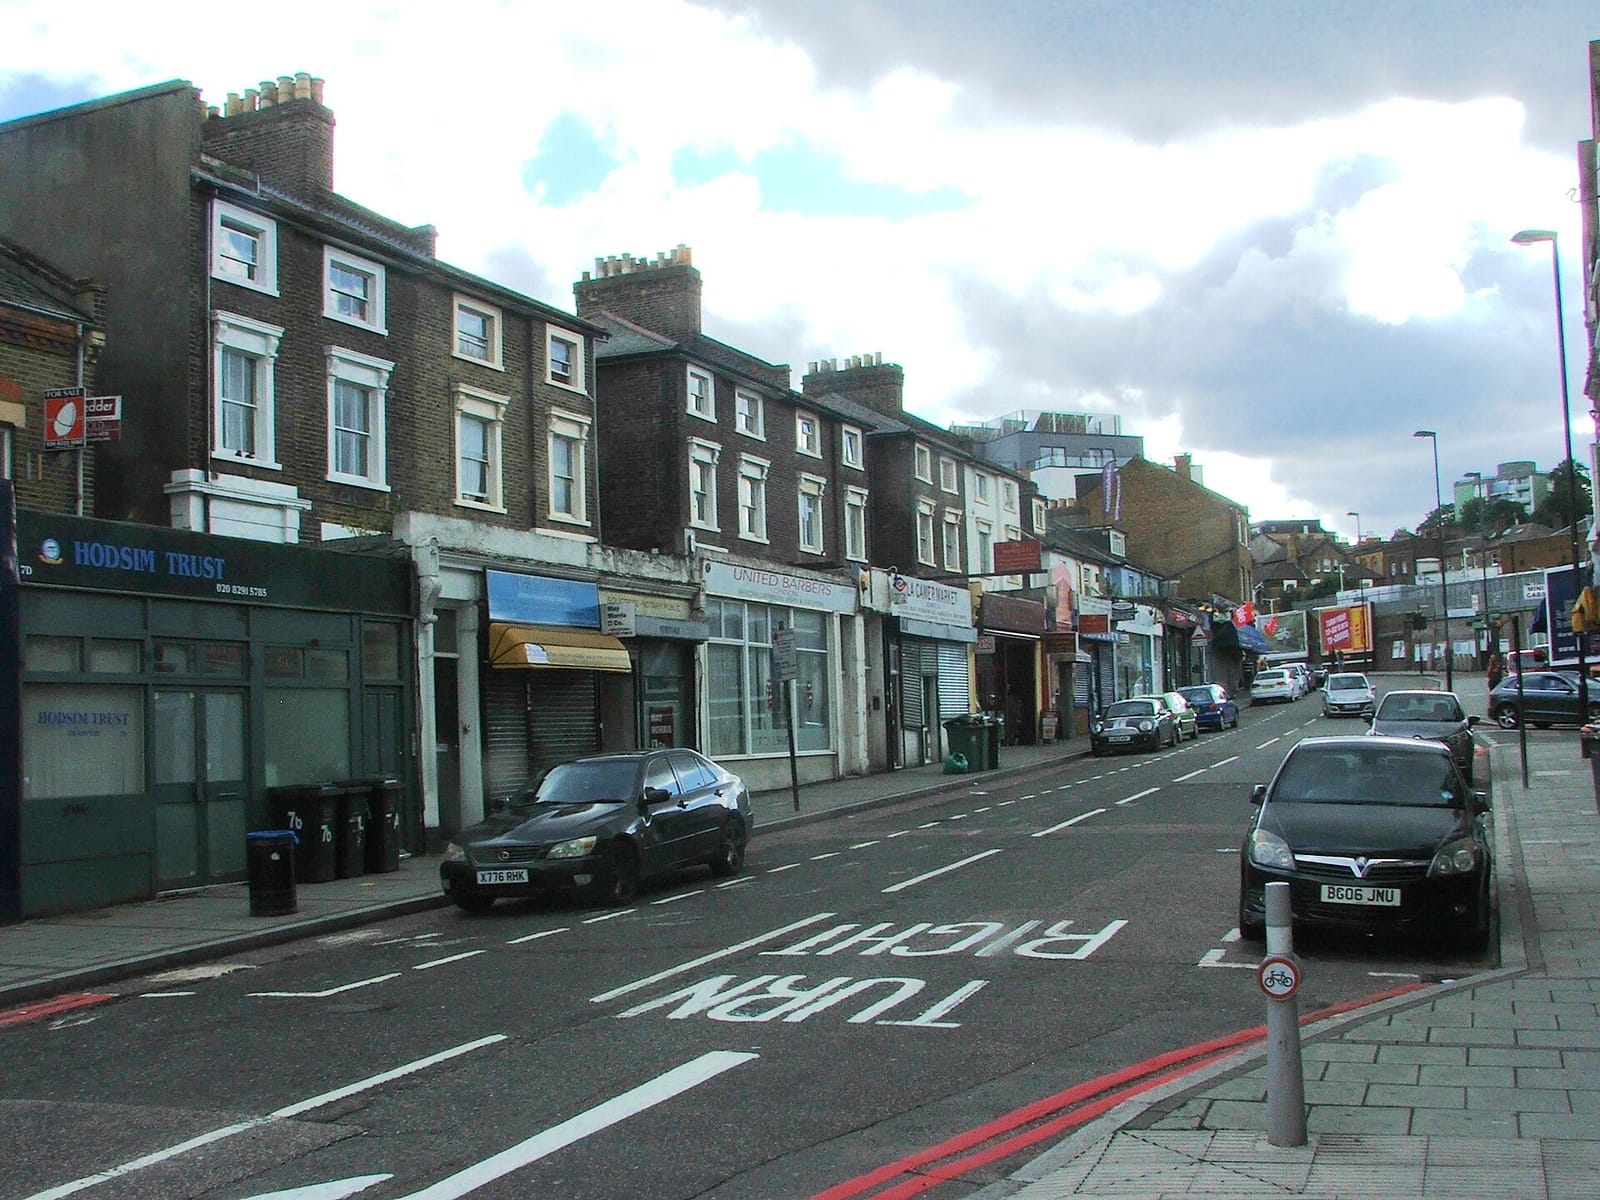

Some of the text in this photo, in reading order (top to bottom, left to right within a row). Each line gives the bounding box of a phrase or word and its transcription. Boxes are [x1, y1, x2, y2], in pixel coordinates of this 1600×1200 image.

[46, 388, 81, 398] FOR SALE
[73, 540, 226, 580] HODSIM TRUST
[733, 567, 832, 596] UNITED BARBERS
[37, 711, 129, 725] HODSIM TRUST
[480, 870, 526, 883] X776 RHK
[1327, 886, 1395, 902] BG06 JNU
[758, 919, 1129, 961] RIGHT
[616, 974, 990, 1029] TURN
